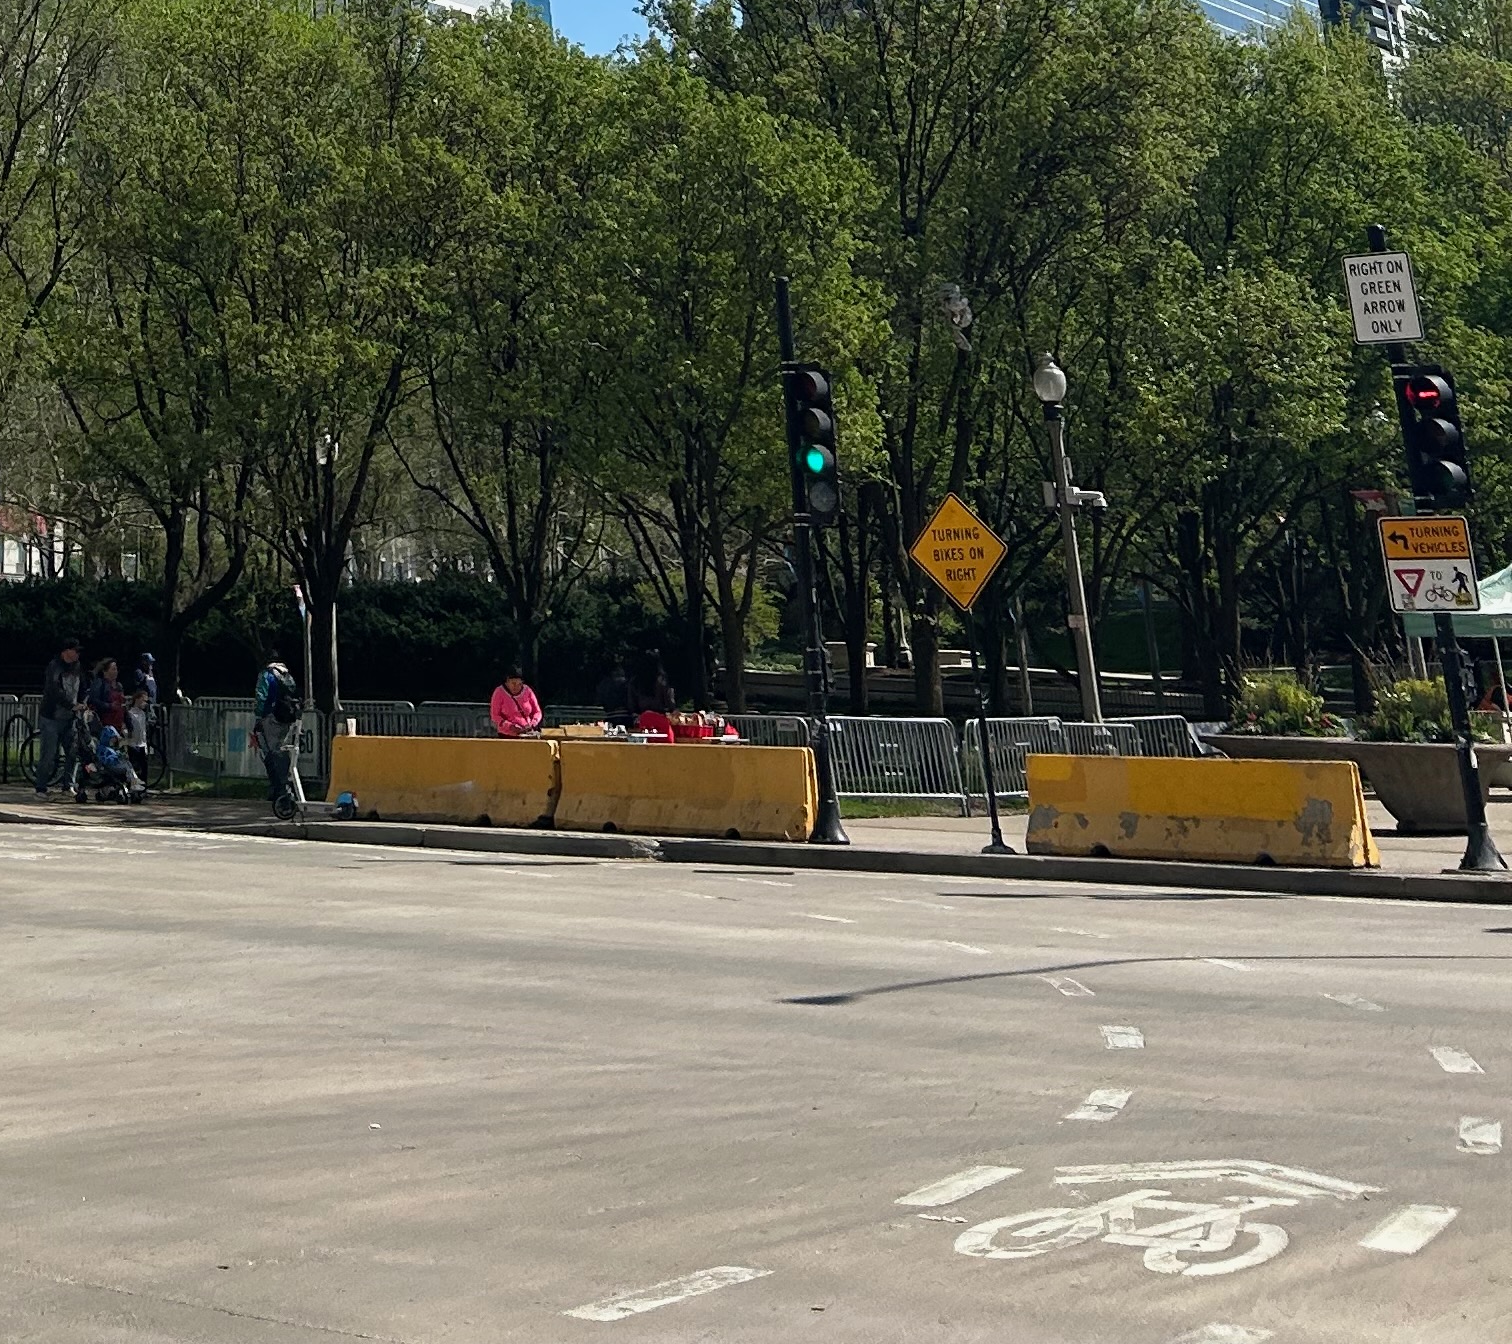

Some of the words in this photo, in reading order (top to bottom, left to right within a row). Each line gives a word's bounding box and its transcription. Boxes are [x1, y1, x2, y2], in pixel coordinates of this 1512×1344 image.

[1349, 261, 1384, 277] RIGHT
[1386, 260, 1404, 274] ON
[1360, 280, 1402, 295] GREEN
[1363, 299, 1406, 315] ARROW
[1371, 319, 1403, 334] ONLY
[931, 527, 980, 541] TURNING
[1408, 526, 1460, 538] TURNING
[933, 548, 964, 562] BIKES
[969, 546, 985, 560] ON
[1411, 541, 1466, 554] VEHICLES
[946, 568, 977, 582] RIGHT
[1430, 571, 1442, 580] TO
